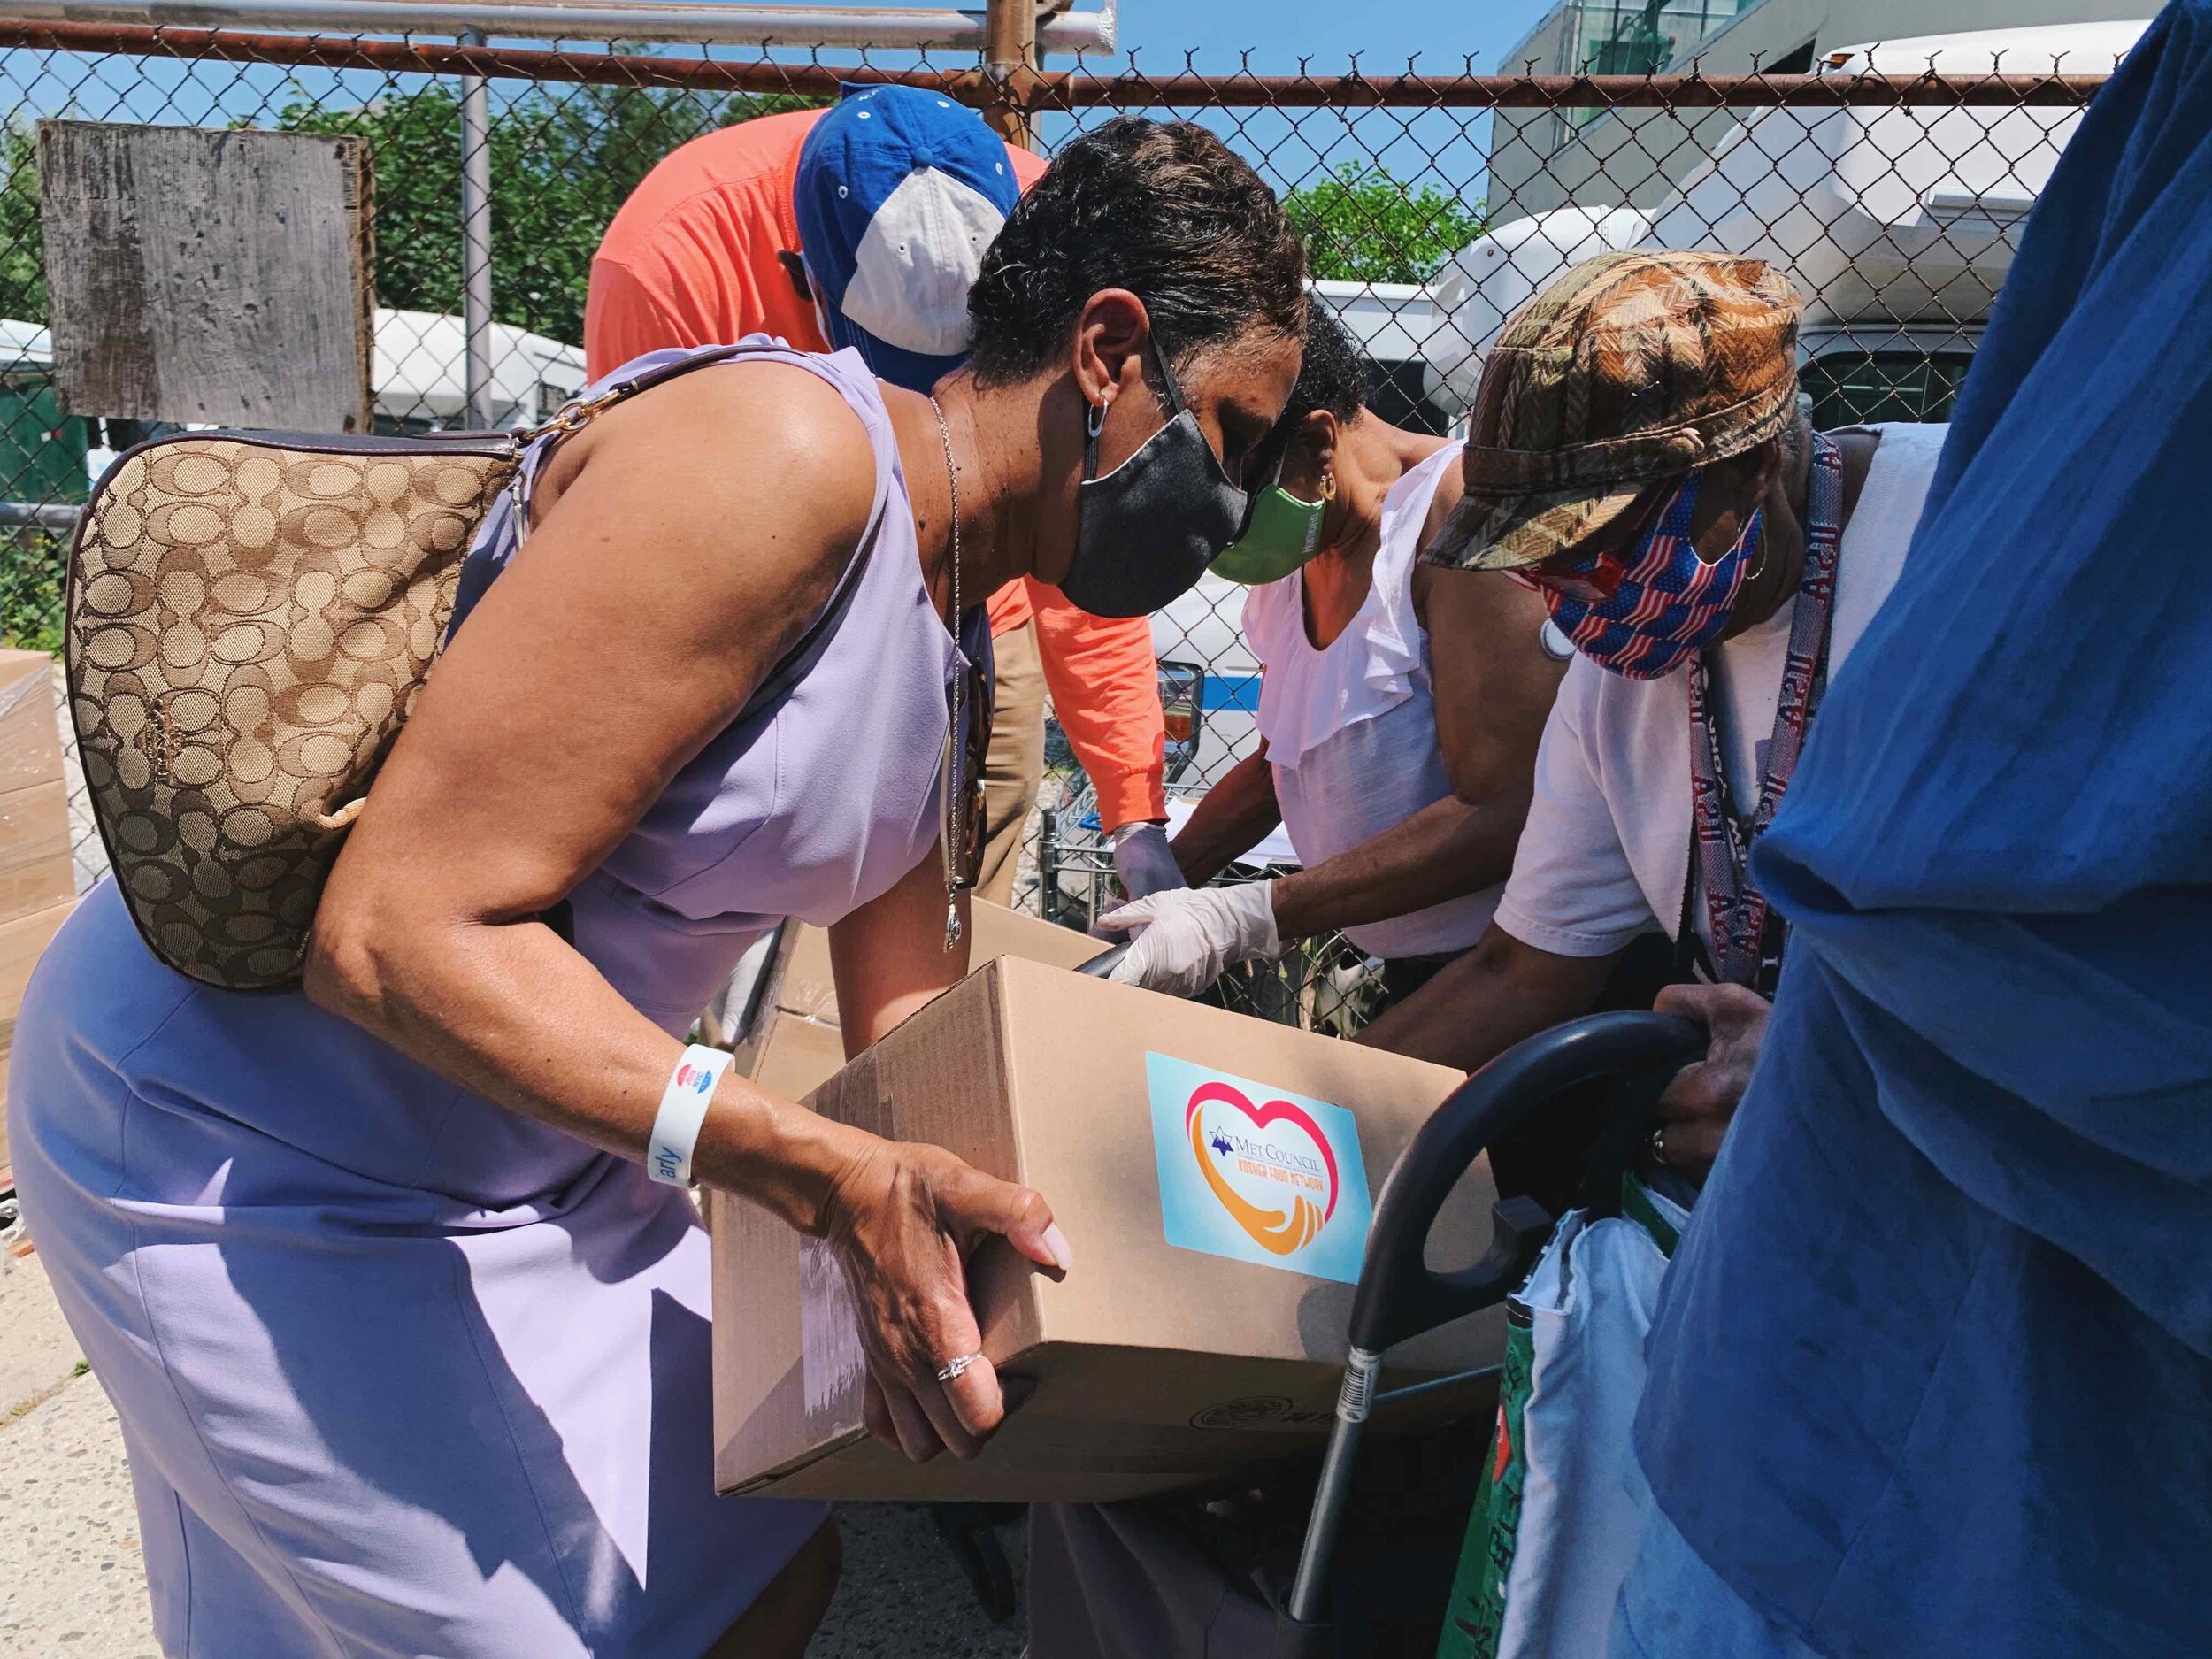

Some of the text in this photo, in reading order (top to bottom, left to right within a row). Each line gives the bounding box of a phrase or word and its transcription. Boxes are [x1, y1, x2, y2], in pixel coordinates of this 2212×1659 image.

[1301, 511, 1318, 554] Humana
[692, 1071, 704, 1088] NYC
[655, 1146, 681, 1178] arly
[1235, 1136, 1263, 1156] MET
[1265, 1144, 1320, 1171] COUNCIL
[1238, 1159, 1267, 1177] KOSHER
[1270, 1166, 1288, 1183] FOOD
[1290, 1172, 1324, 1191] NETWORK
